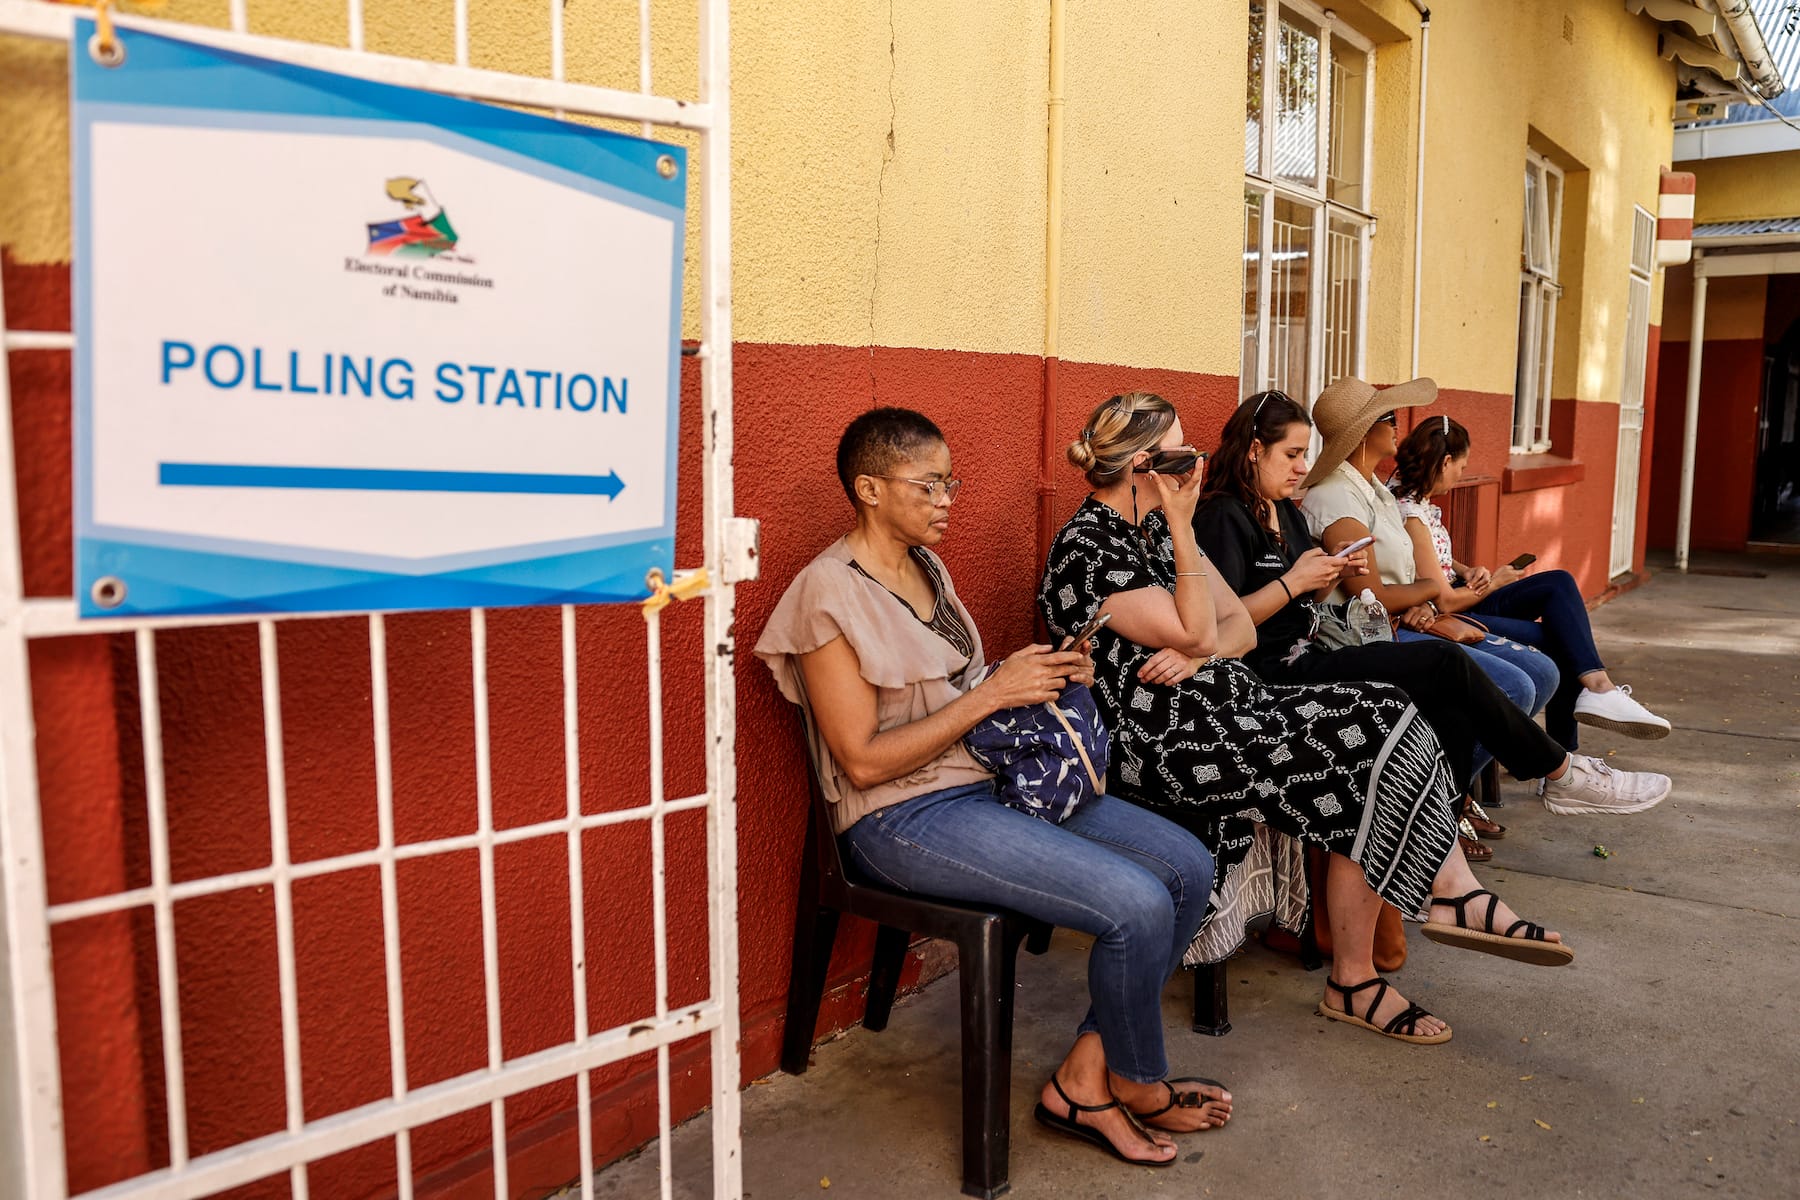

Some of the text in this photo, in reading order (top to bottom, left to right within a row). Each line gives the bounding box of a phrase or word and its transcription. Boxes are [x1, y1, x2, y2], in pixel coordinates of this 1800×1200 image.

[345, 257, 408, 278] Electoral
[412, 266, 494, 288] Commission
[383, 284, 459, 304] of Namibia
[161, 340, 629, 415] POLLING STATION
